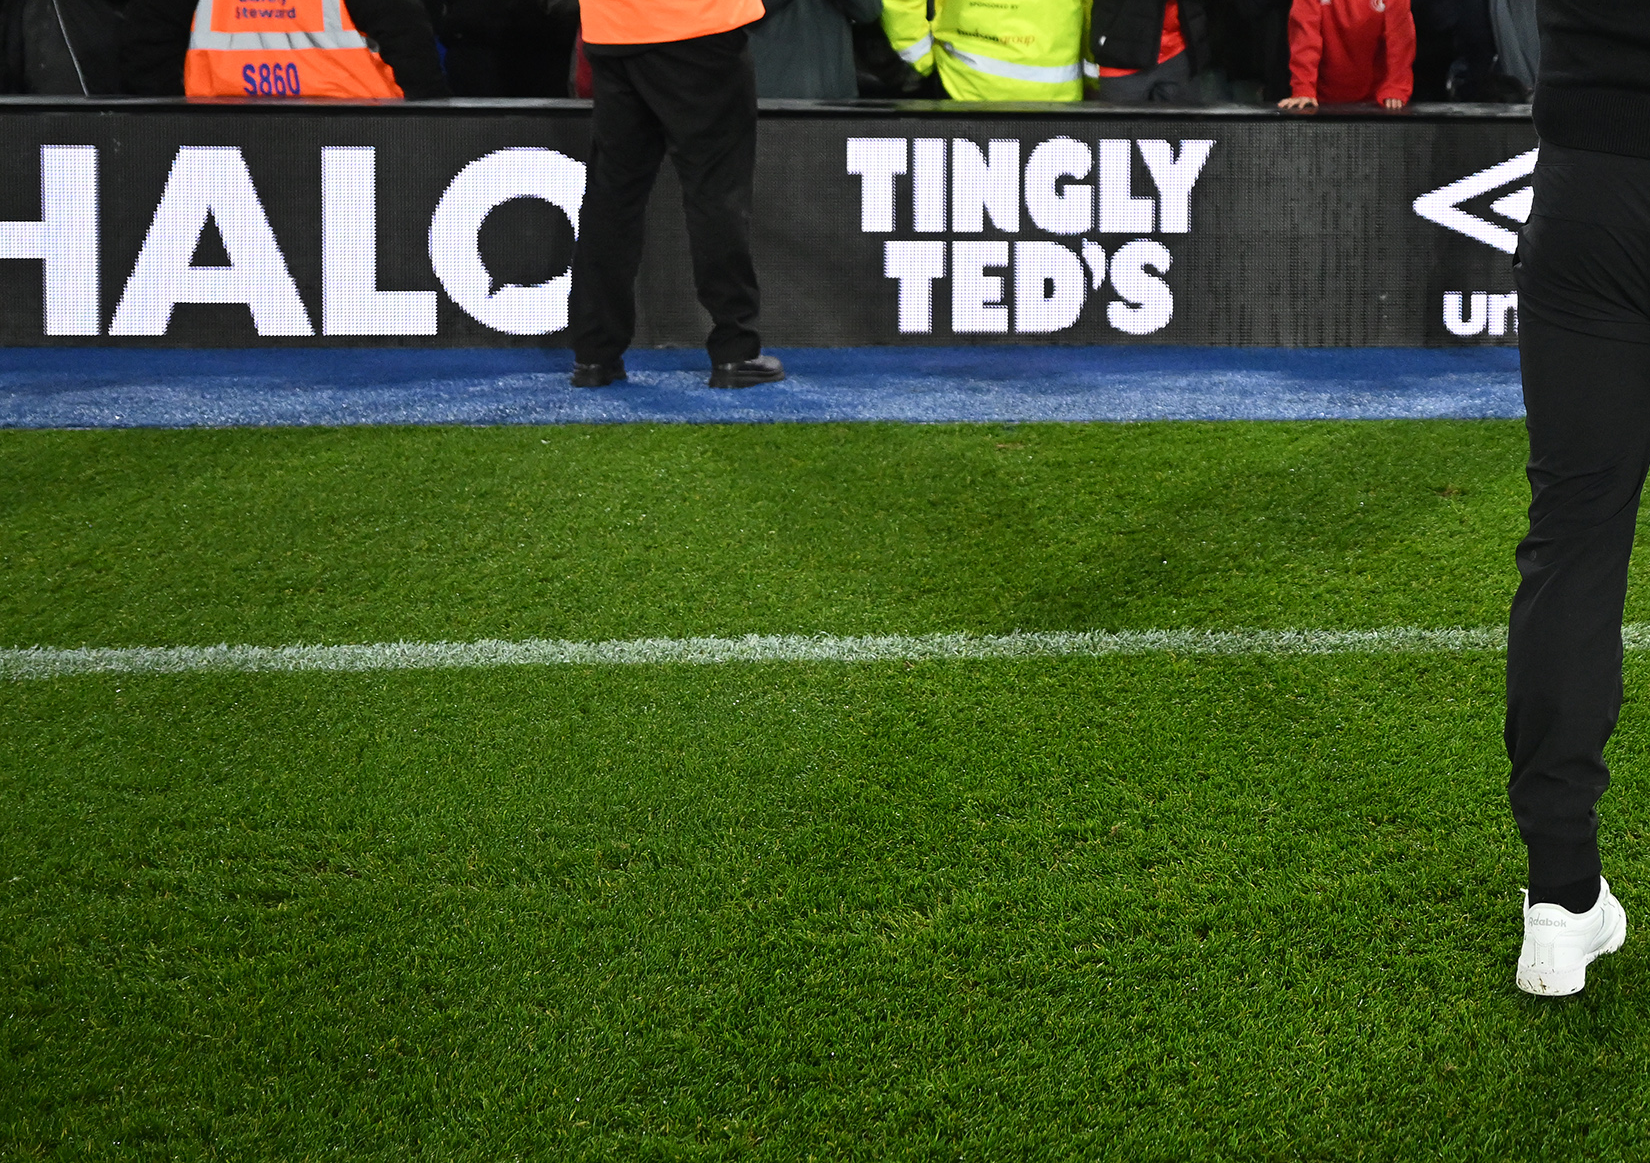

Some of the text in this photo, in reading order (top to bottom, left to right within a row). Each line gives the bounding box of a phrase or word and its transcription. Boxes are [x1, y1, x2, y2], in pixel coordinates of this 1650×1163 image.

[242, 62, 300, 96] S860
[846, 135, 1217, 235] TINGLY
[883, 237, 1174, 336] TED'S
